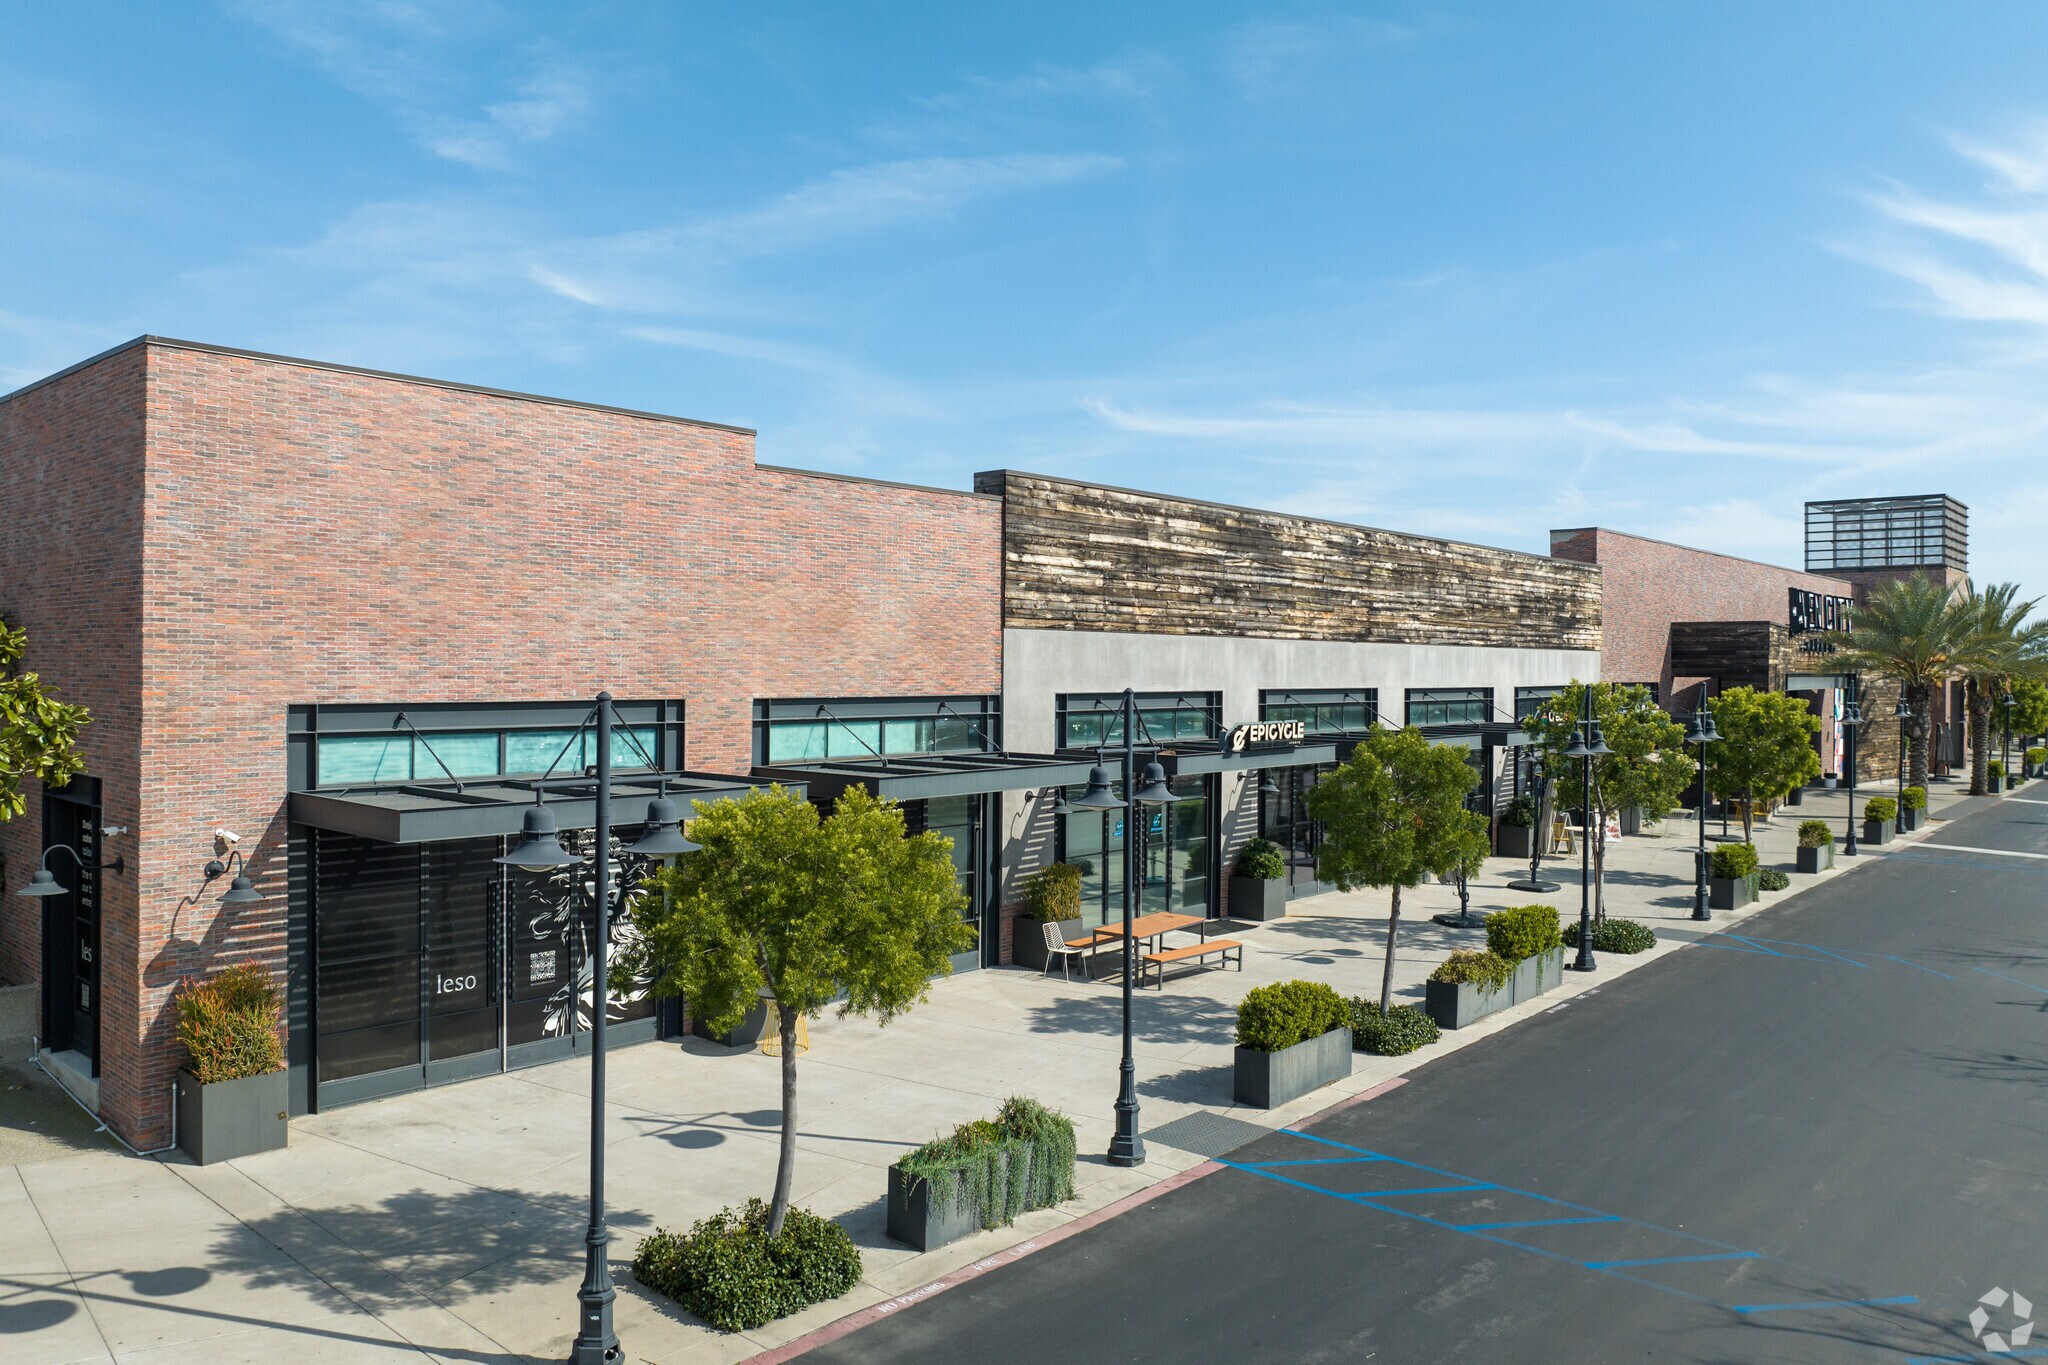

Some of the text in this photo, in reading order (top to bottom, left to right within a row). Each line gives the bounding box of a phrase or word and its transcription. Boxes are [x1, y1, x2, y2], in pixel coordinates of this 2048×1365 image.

[1250, 722, 1304, 742] EPICYCLE
[82, 938, 92, 962] les
[436, 974, 477, 994] leso
[877, 1302, 898, 1313] NO
[896, 1282, 946, 1304] PARKING
